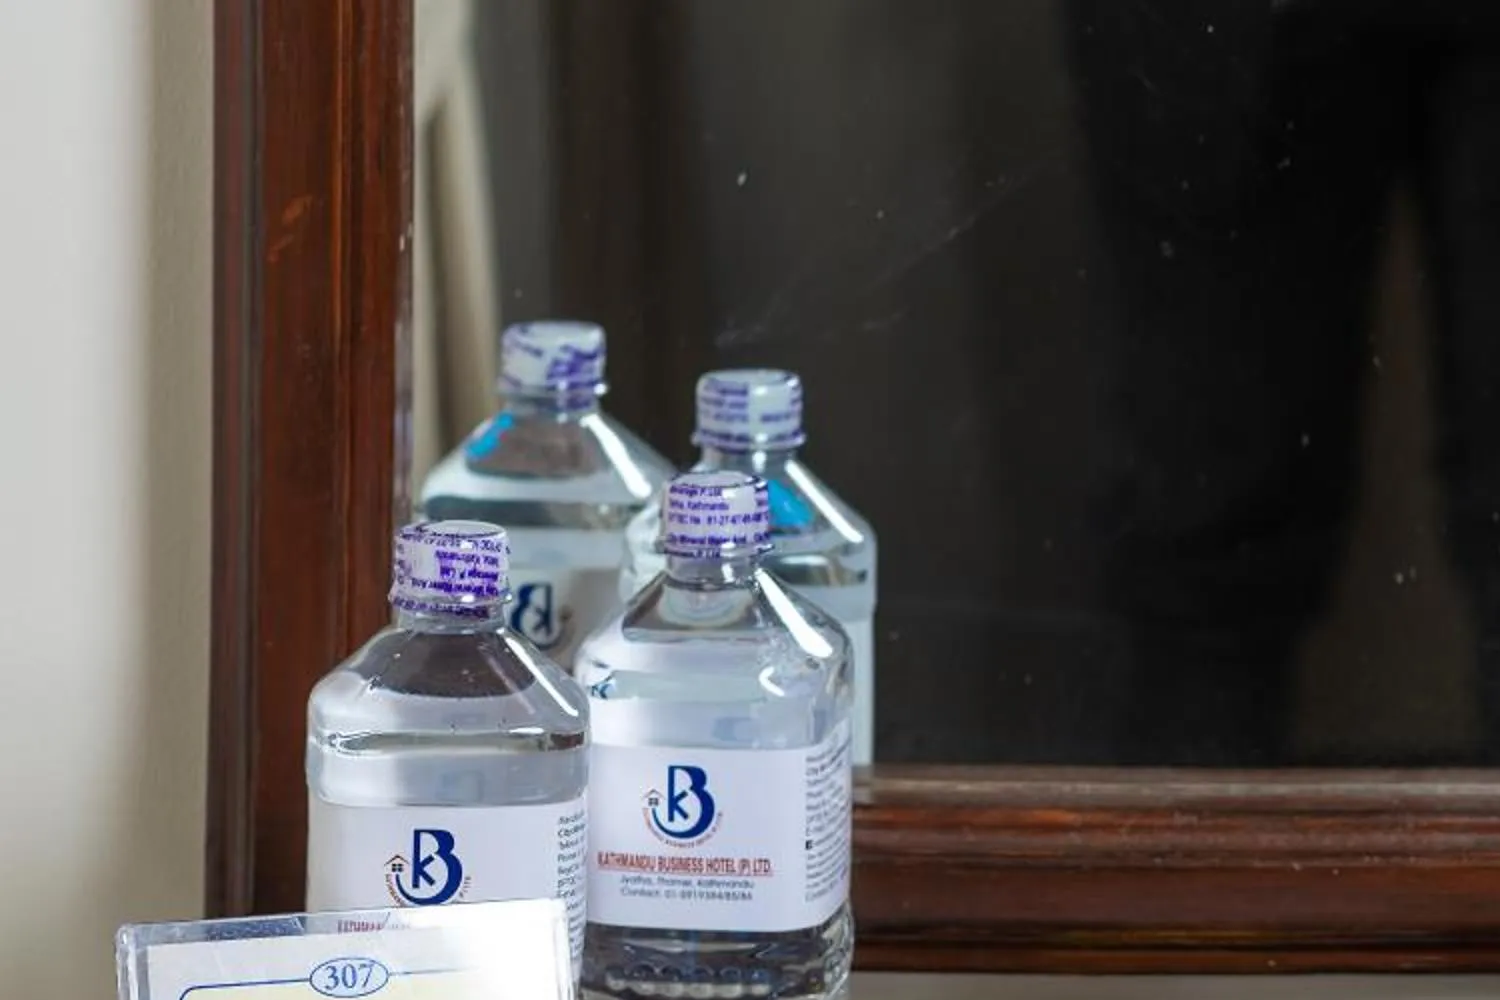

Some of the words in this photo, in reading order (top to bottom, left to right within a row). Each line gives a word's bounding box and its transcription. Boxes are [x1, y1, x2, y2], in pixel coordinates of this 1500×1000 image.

[597, 851, 655, 872] KATHMANDU
[658, 855, 704, 873] BUSINESS
[706, 857, 736, 873] HOTEL
[324, 963, 376, 990] 307
